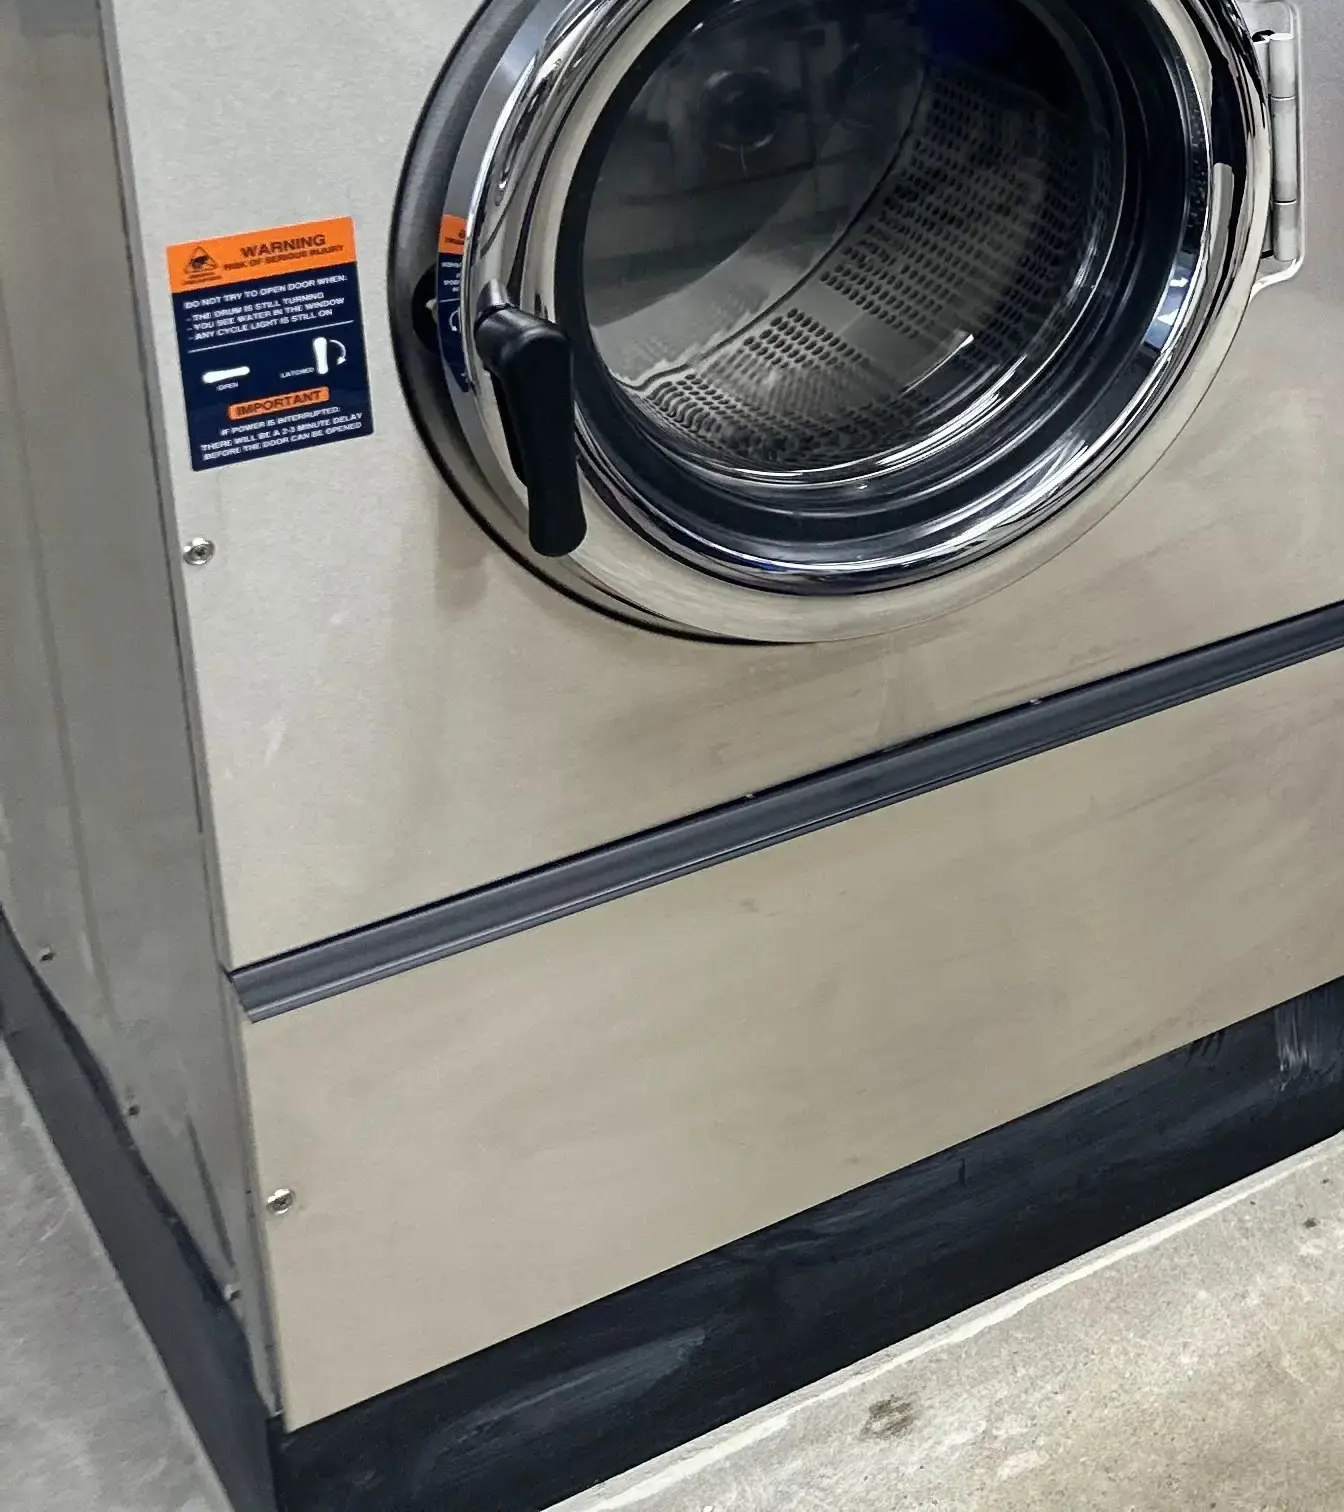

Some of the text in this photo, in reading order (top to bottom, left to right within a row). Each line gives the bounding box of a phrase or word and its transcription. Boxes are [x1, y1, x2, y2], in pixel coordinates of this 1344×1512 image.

[223, 245, 344, 270] RISK OF SERIOUS INJURY
[240, 234, 326, 257] WARNING
[184, 300, 200, 309] DO
[202, 296, 221, 306] NOT
[223, 293, 242, 302] TRY
[244, 290, 258, 298] TO
[260, 285, 286, 296] OPEN
[287, 279, 315, 290] DOOR
[192, 312, 211, 321] THE
[214, 307, 242, 318] DRUM
[255, 300, 281, 310] STILL
[283, 292, 324, 305] TURNING
[193, 322, 215, 330] YOU
[217, 318, 235, 327] SEE
[237, 310, 273, 323] WATER
[284, 305, 303, 314] THE
[305, 297, 345, 310] WINDOW
[194, 331, 215, 340] ANY
[217, 325, 248, 336] CYCLE
[250, 319, 278, 330] LIGHT
[291, 312, 317, 323] STILL
[318, 309, 332, 317] ON
[237, 390, 321, 416] IMPORTANT
[201, 440, 232, 451] THERE
[234, 435, 256, 445] WILL
[282, 427, 295, 435] 2-3
[297, 419, 331, 432] MINUTE
[332, 412, 362, 424] DELAY
[203, 422, 362, 460] BEFORE THE DOOR CAN BE OPENED
[231, 421, 265, 434] POWER
